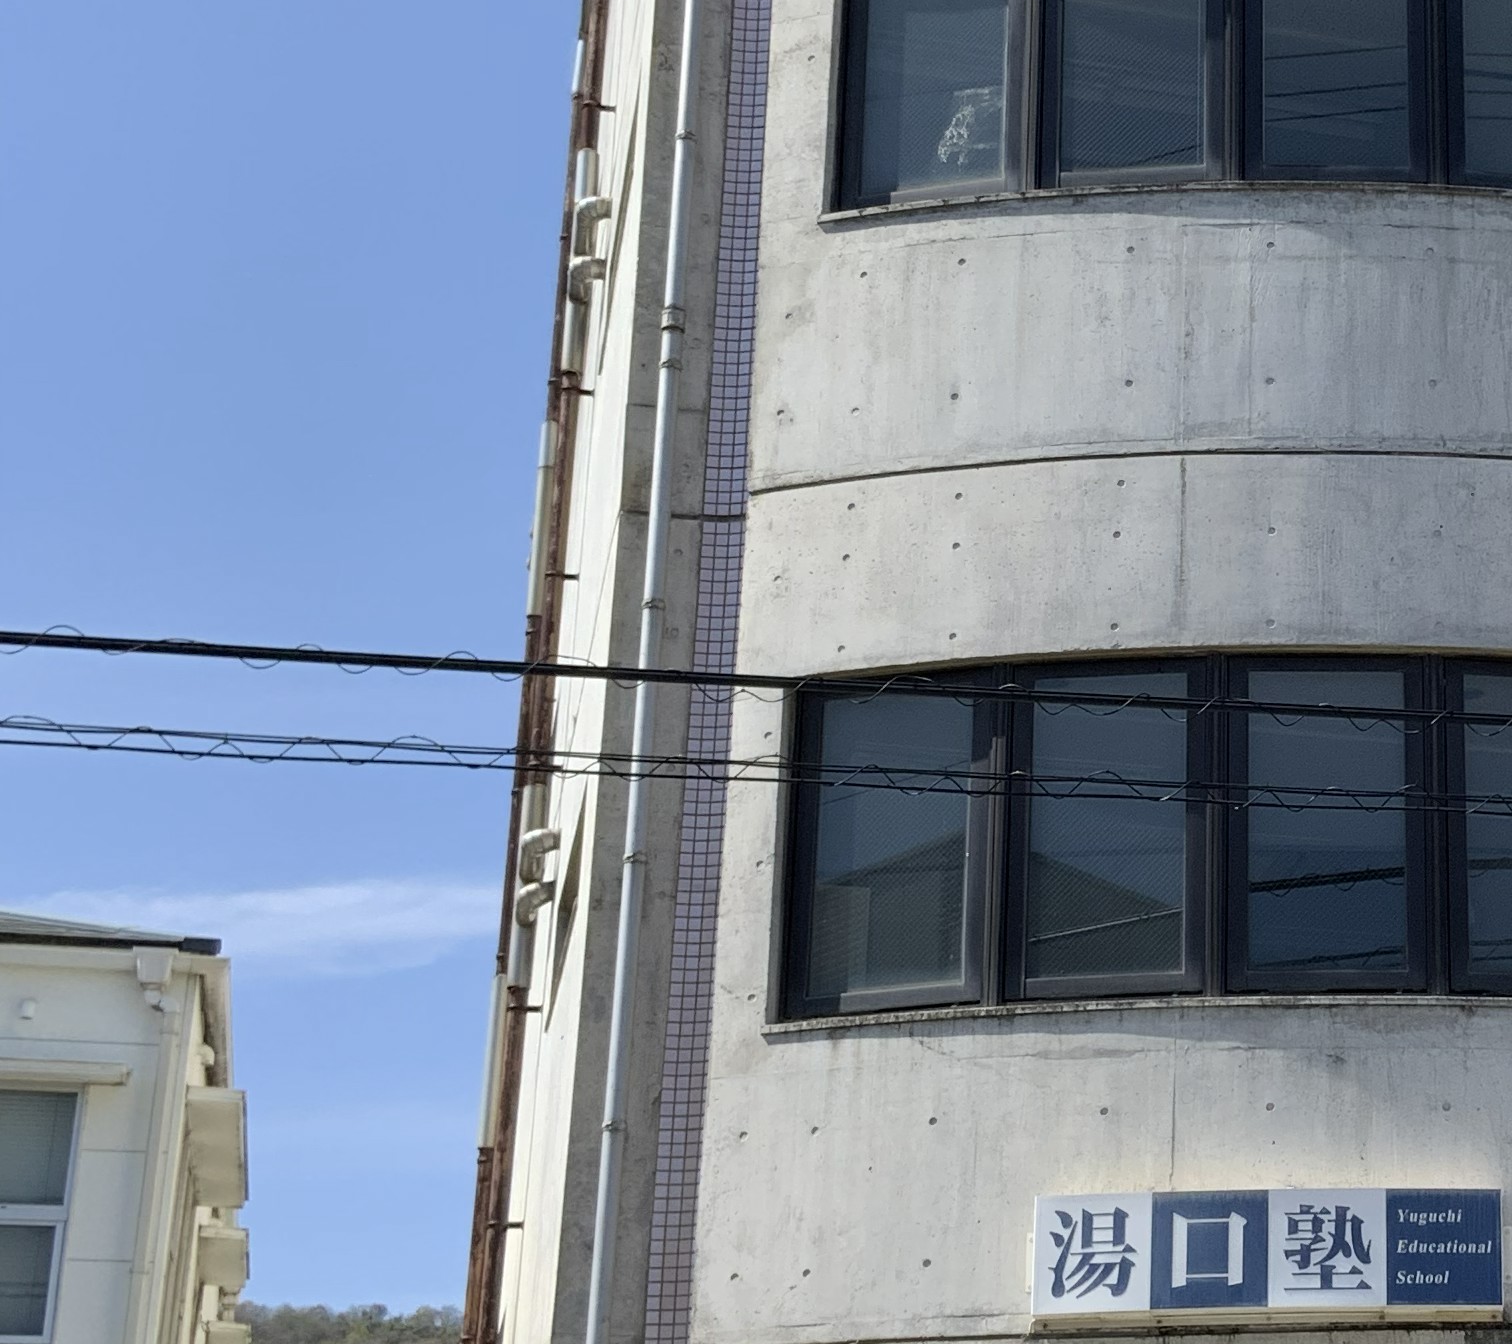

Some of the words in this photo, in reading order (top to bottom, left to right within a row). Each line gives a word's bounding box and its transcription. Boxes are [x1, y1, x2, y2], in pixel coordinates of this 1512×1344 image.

[1397, 1208, 1463, 1226] Yuguchi
[1049, 1203, 1373, 1299] 湯口塾
[1396, 1239, 1493, 1254] Educational
[1395, 1270, 1450, 1285] School
